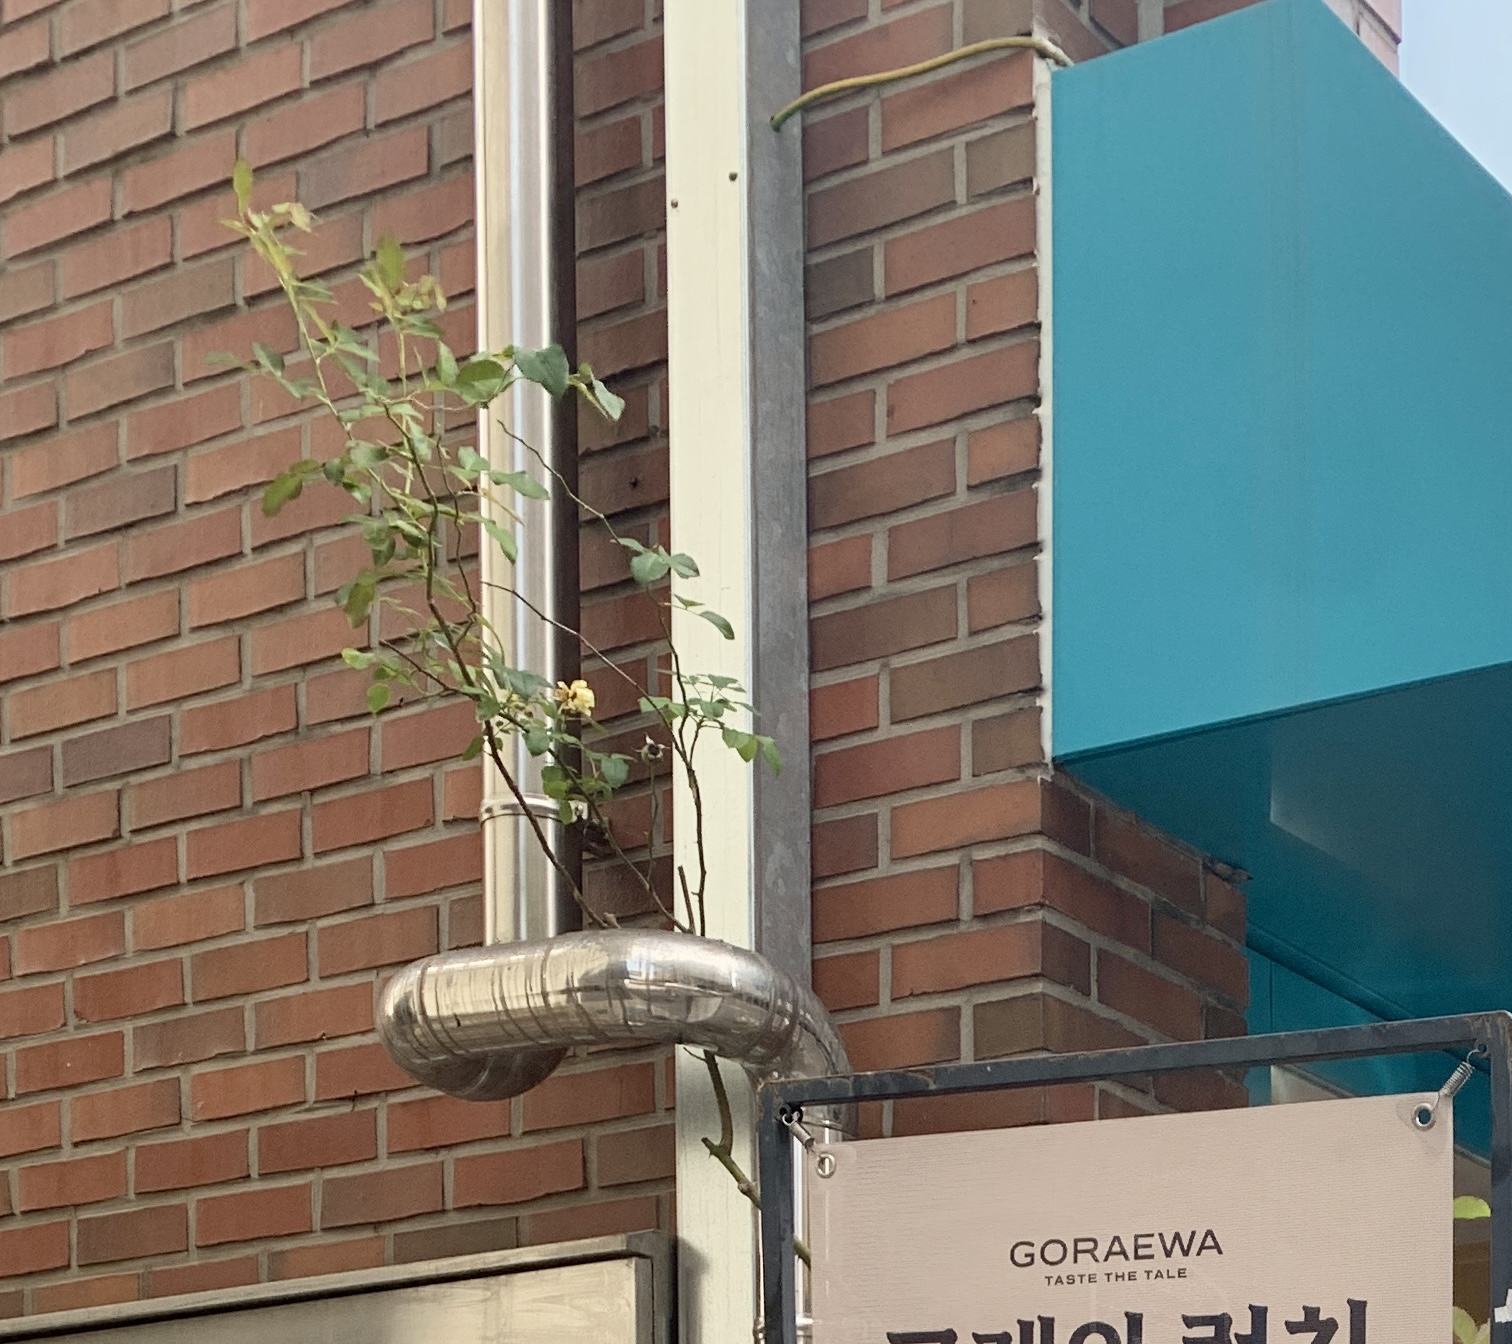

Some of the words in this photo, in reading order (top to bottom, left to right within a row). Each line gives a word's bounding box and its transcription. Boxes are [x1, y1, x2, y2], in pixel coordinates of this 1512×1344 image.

[1009, 1228, 1224, 1268] GORAEWA
[1045, 1273, 1098, 1286] TASTE
[1104, 1271, 1138, 1283] THE
[1144, 1268, 1188, 1281] TALE
